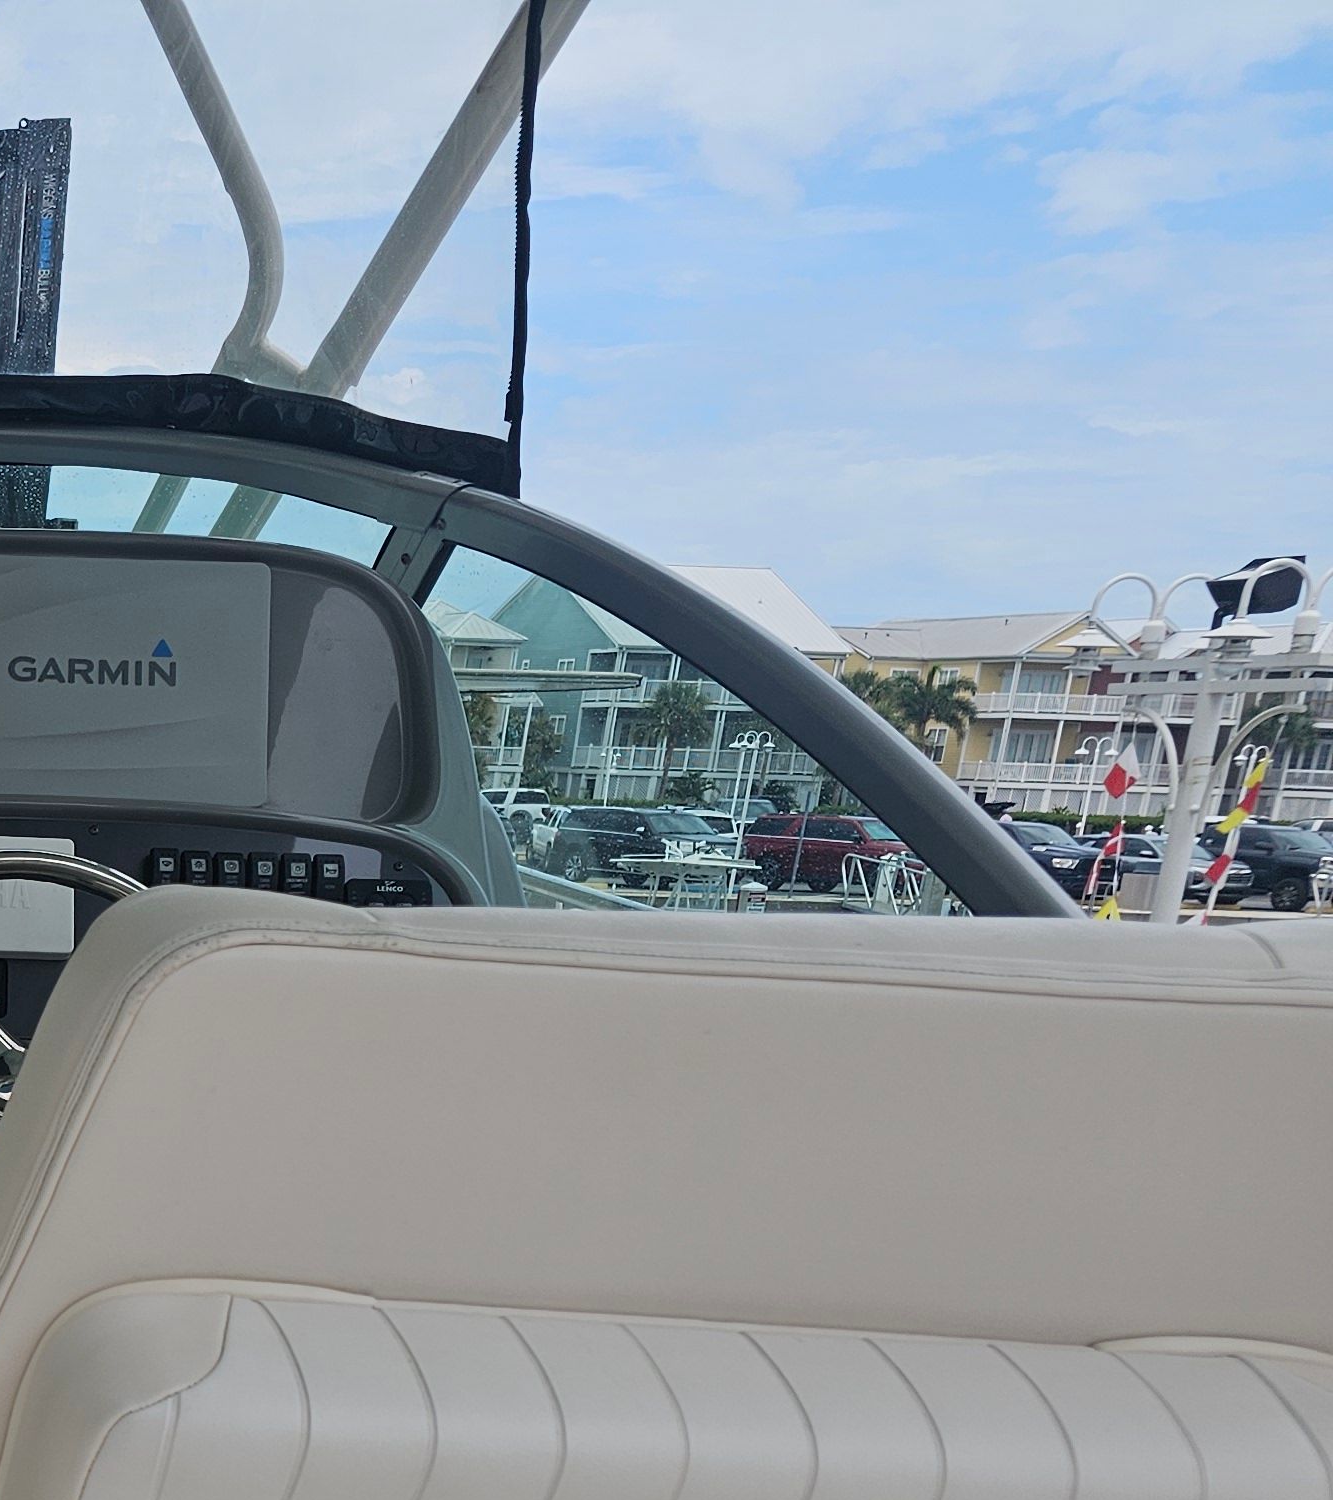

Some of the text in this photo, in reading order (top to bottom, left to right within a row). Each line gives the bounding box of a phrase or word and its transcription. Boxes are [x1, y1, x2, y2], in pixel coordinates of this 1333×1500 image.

[40, 173, 56, 219] WIGGINS
[8, 656, 176, 687] GARMIN
[376, 885, 404, 893] LENCO
